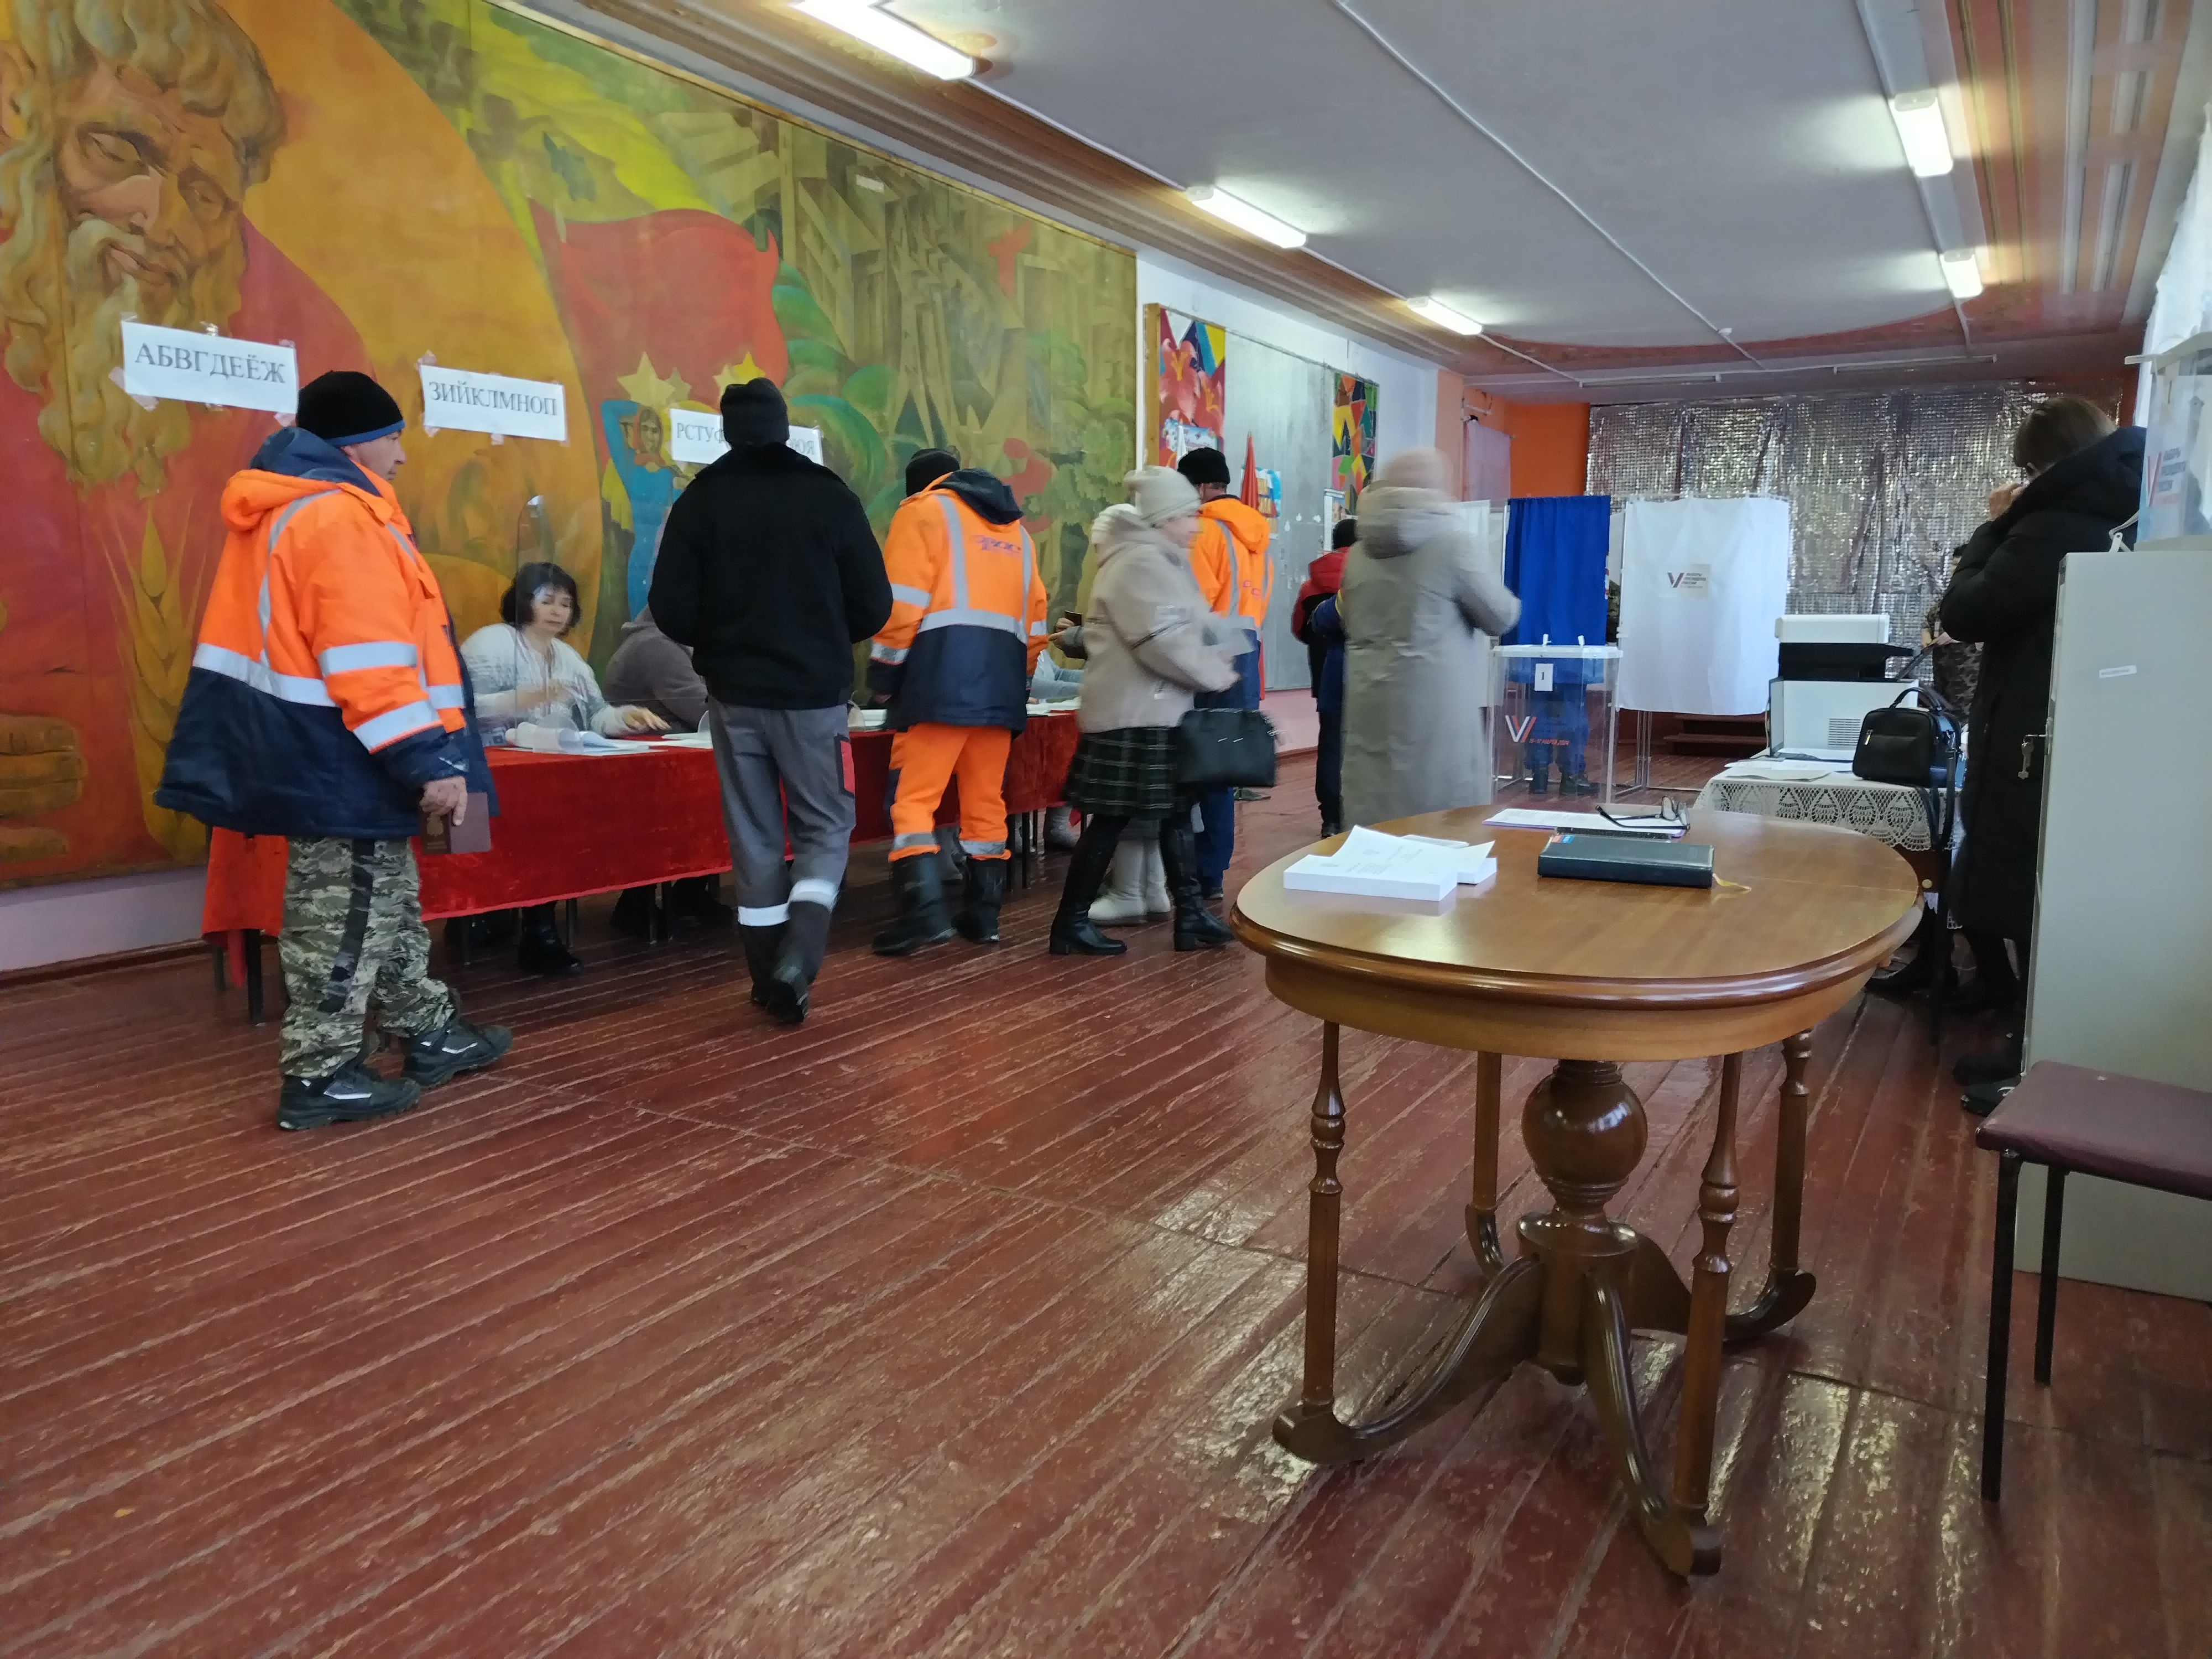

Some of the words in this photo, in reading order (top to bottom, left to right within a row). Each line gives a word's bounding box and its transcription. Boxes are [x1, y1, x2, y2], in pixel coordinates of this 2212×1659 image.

[135, 342, 285, 384] АБВГДЕЁЖ
[429, 380, 557, 416] ЗИЙКЛМНОП
[1540, 671, 1545, 681] 1
